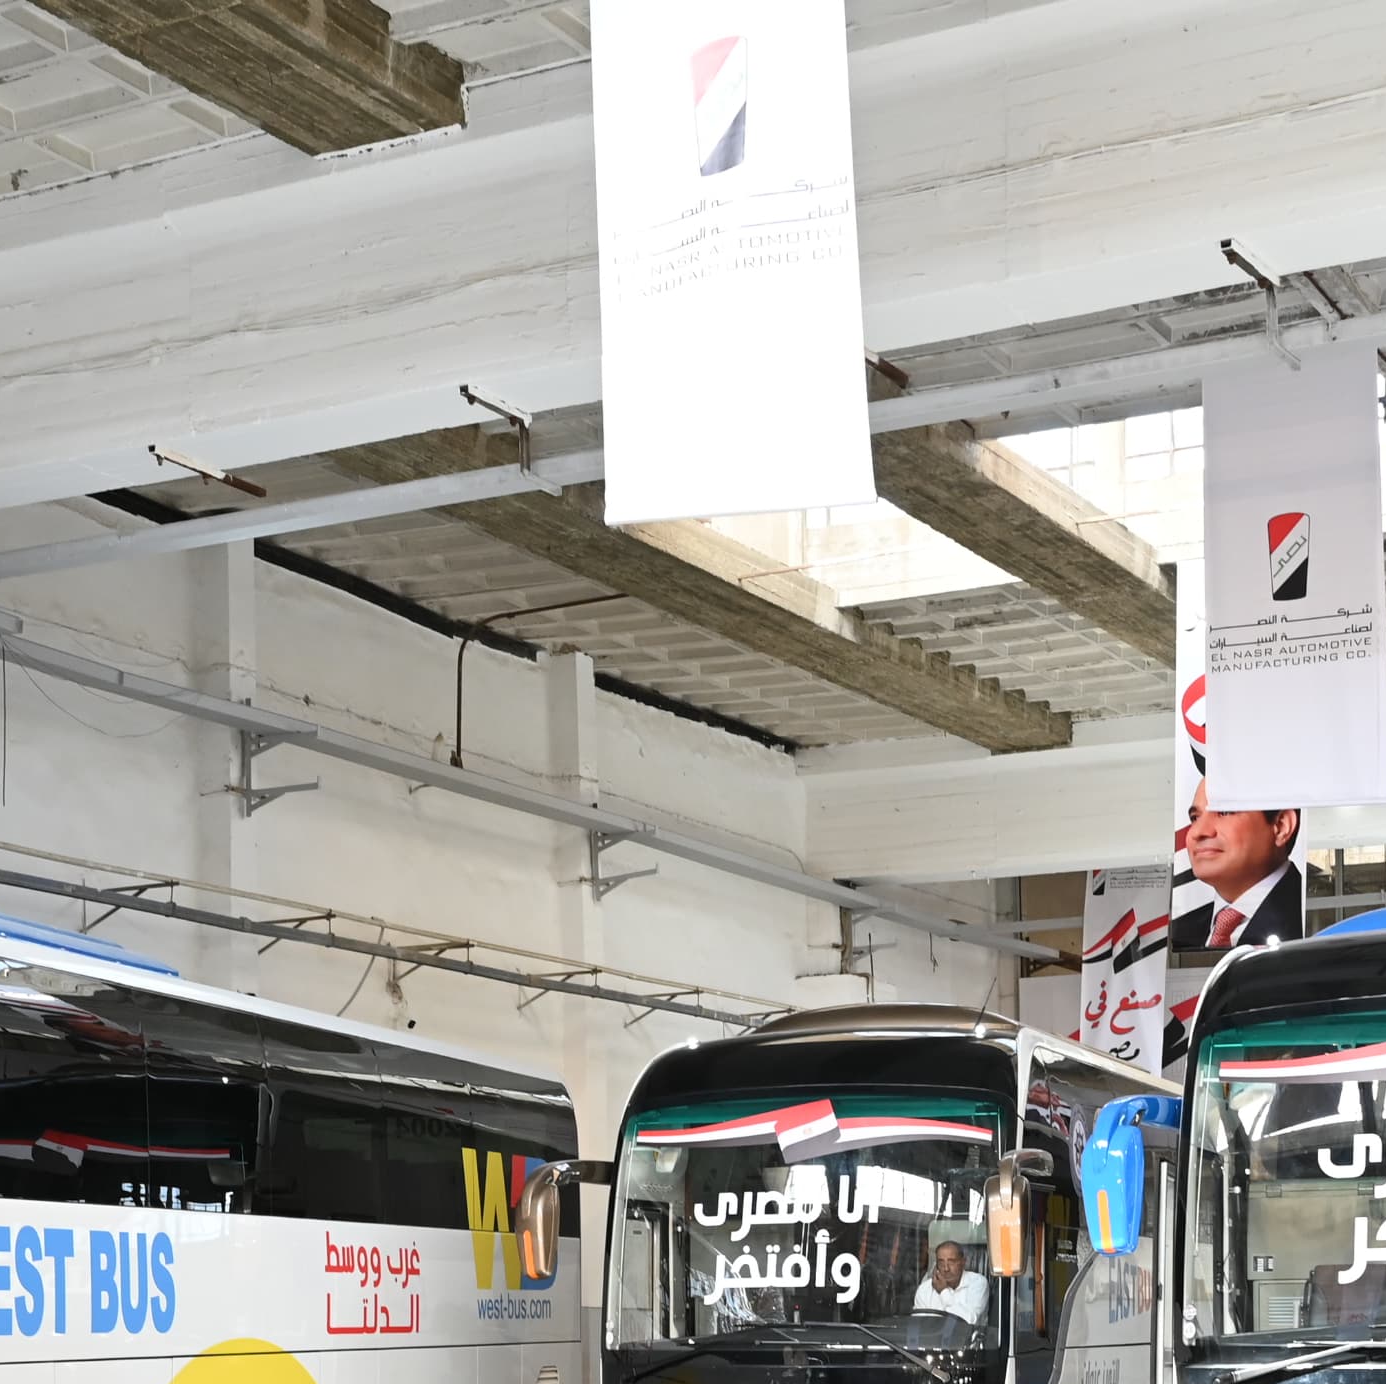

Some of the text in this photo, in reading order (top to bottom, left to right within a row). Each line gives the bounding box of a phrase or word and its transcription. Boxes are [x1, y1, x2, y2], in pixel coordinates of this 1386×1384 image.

[1209, 603, 1373, 633] شركة النصر
[1209, 622, 1373, 650] لصناعة السيارات
[1211, 637, 1372, 663] EL NASR AUTOMOTIVE
[1211, 649, 1372, 674] MANUFACTURING CO.
[1110, 990, 1162, 1036] صنع
[324, 1231, 421, 1289] غرب ووسط
[703, 1229, 862, 1305] وأفتخر
[89, 1229, 176, 1336] BUS
[1108, 1256, 1153, 1324] EAST BU
[326, 1292, 420, 1335] الدلتا
[477, 1296, 552, 1322] west-bus.com
